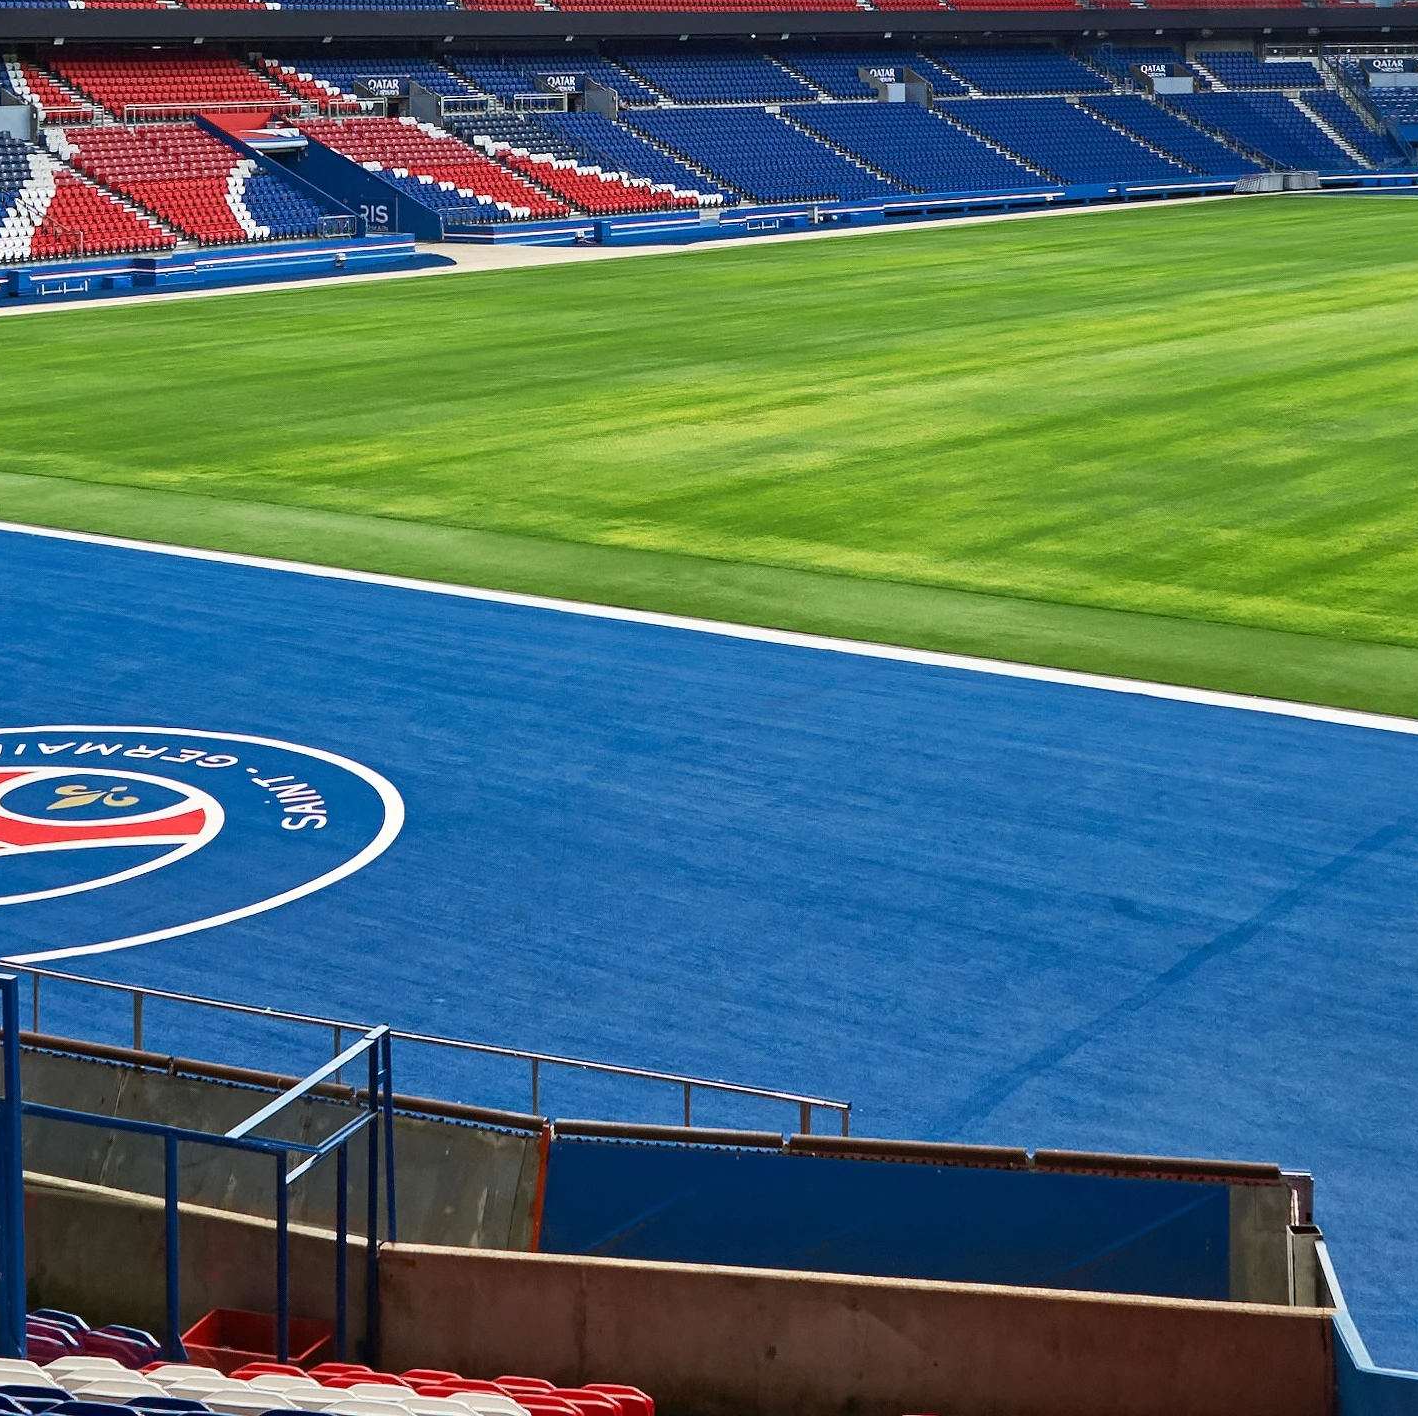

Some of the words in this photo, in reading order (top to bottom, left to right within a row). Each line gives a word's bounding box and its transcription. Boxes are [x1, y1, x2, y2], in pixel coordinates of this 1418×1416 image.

[1140, 64, 1166, 74] QATAR
[1372, 59, 1403, 69] QATAR
[547, 75, 576, 87] QATAR
